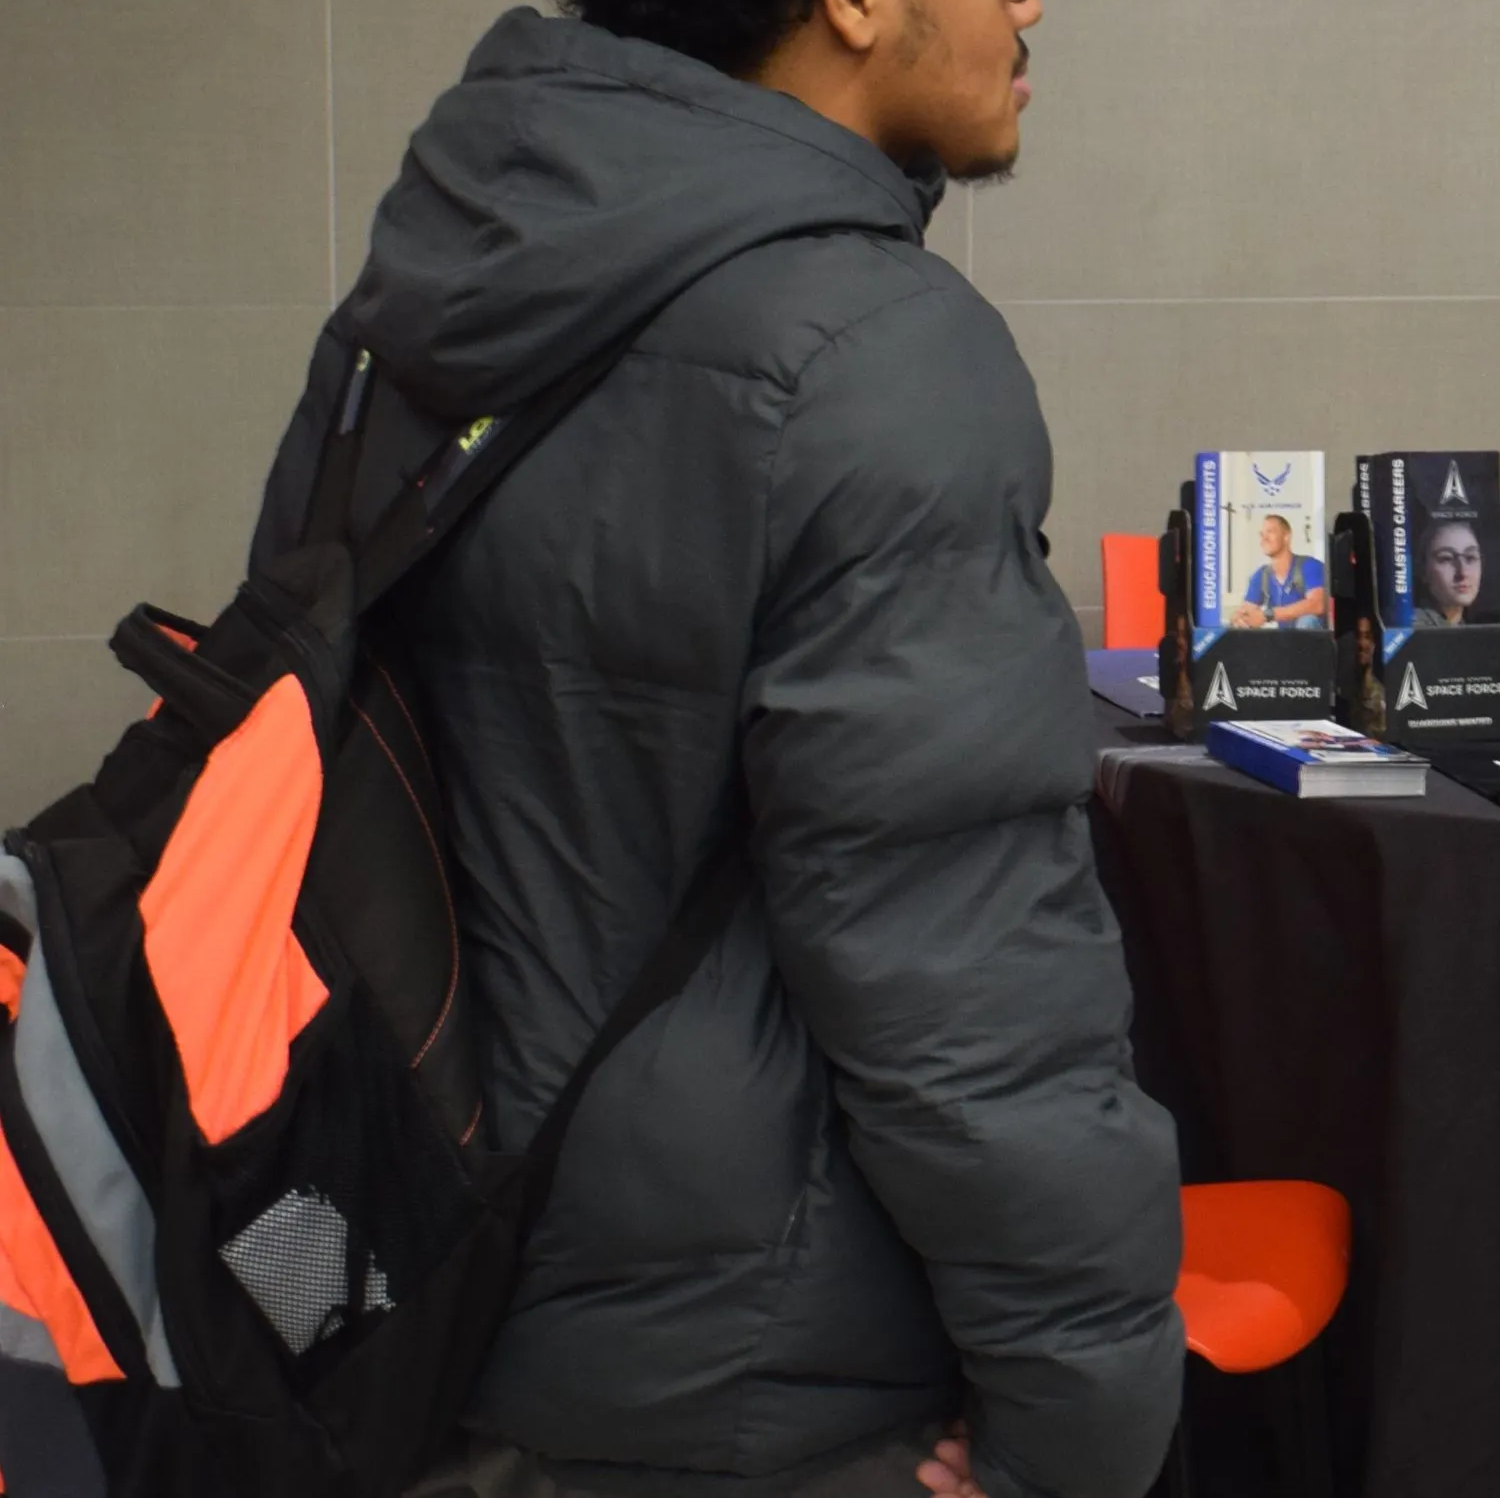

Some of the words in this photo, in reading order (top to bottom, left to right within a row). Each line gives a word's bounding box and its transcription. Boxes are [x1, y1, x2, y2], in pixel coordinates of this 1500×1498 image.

[1202, 460, 1217, 527] BENEFITS
[1391, 458, 1406, 525] CAREERS
[1203, 528, 1217, 610] EDUCATION
[1392, 527, 1407, 594] ENLISTED
[1237, 686, 1277, 699] SPACE
[1279, 686, 1321, 699] FORCE
[1426, 683, 1463, 697] SPACE
